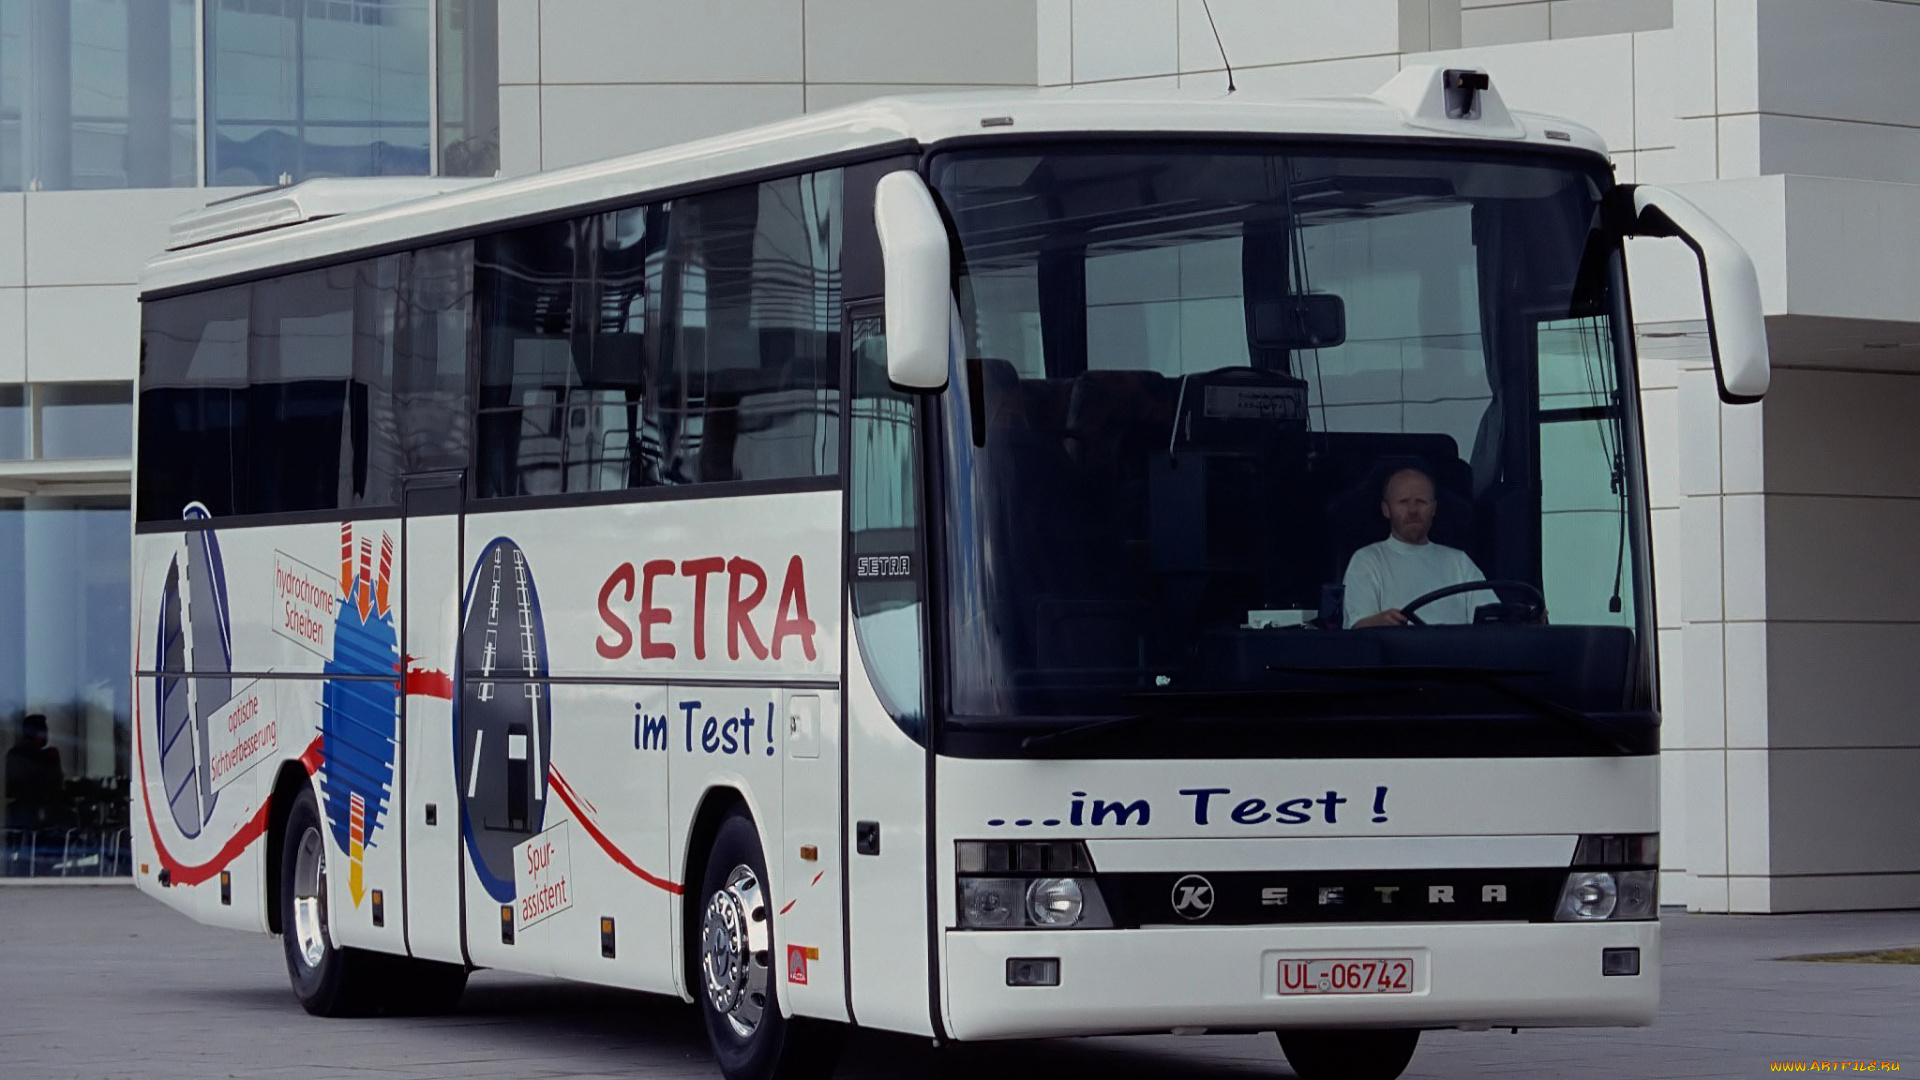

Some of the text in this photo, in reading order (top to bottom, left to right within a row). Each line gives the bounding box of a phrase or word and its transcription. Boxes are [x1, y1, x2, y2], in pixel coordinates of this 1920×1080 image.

[275, 559, 334, 615] hydrochrome
[857, 555, 911, 576] SETRA
[284, 600, 324, 645] Scheiben
[595, 554, 817, 661] SETRA
[228, 695, 259, 736] optische
[633, 702, 668, 751] im
[211, 719, 277, 782] Sichtverbesserung
[526, 842, 555, 880] Spur-
[522, 875, 568, 922] assistent
[1261, 884, 1508, 906] SETRA
[1283, 962, 1408, 990] UL-06742
